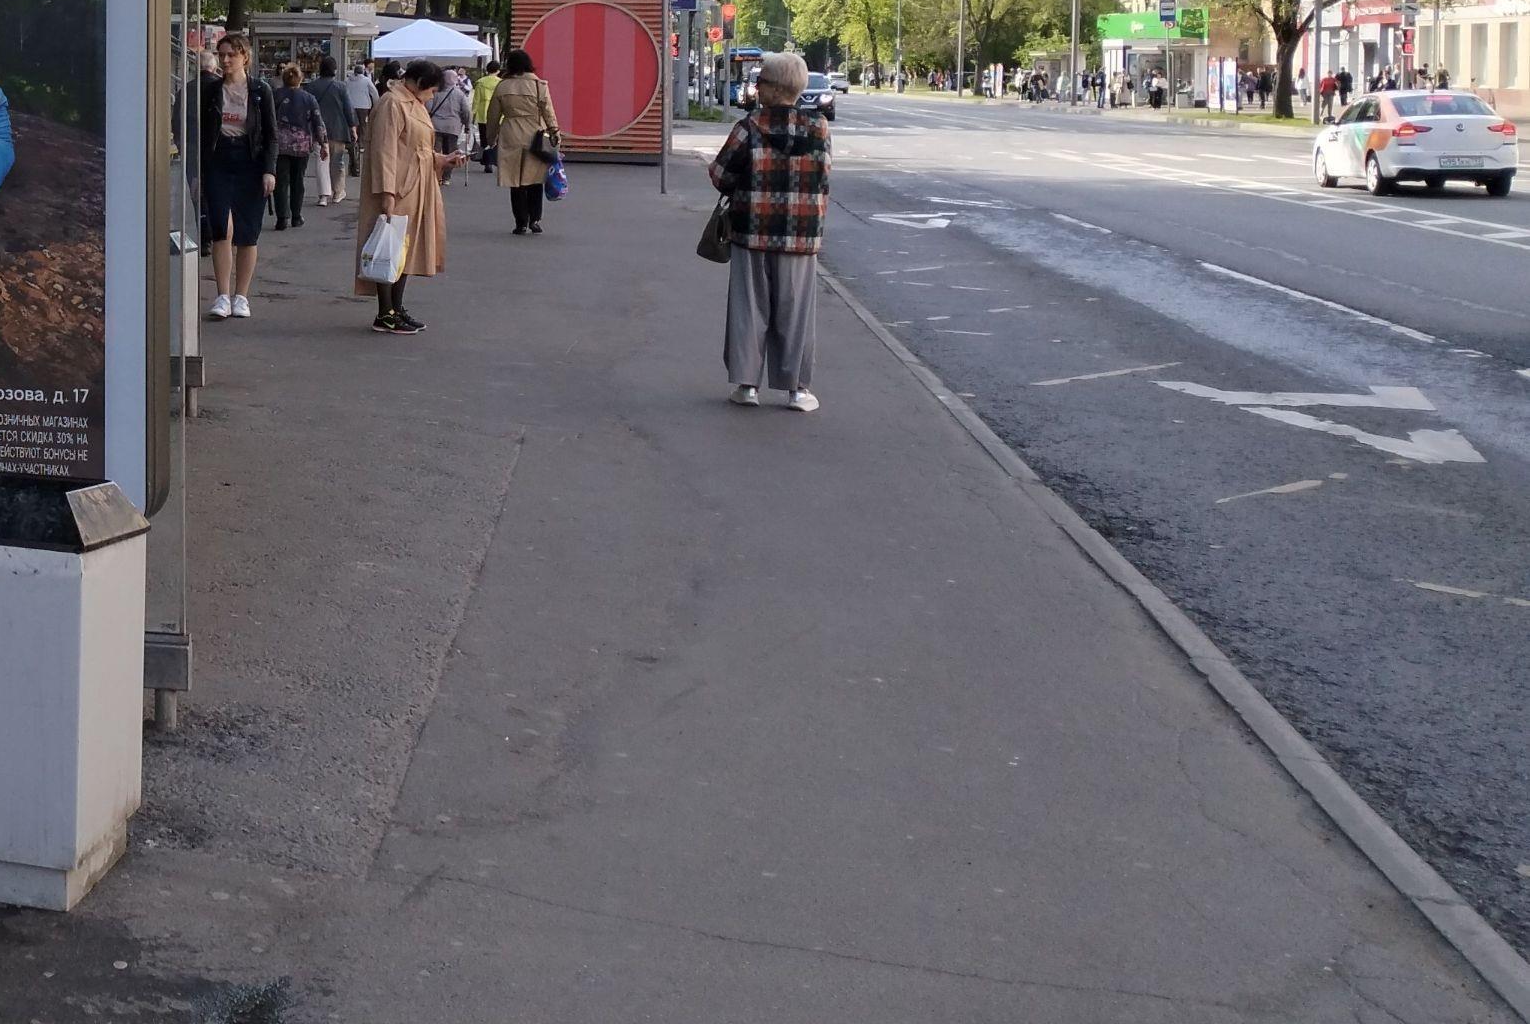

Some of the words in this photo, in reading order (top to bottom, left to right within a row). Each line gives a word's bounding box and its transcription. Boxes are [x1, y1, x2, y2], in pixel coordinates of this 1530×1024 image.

[52, 388, 69, 404] д.
[72, 388, 89, 404] 17
[42, 416, 88, 428] МАГАЗИНАХ
[20, 431, 53, 444] СКИДКА
[56, 432, 73, 444] 30%
[76, 433, 88, 445] НА
[43, 448, 76, 461] БОНУСЫ
[77, 449, 88, 461] НЕ
